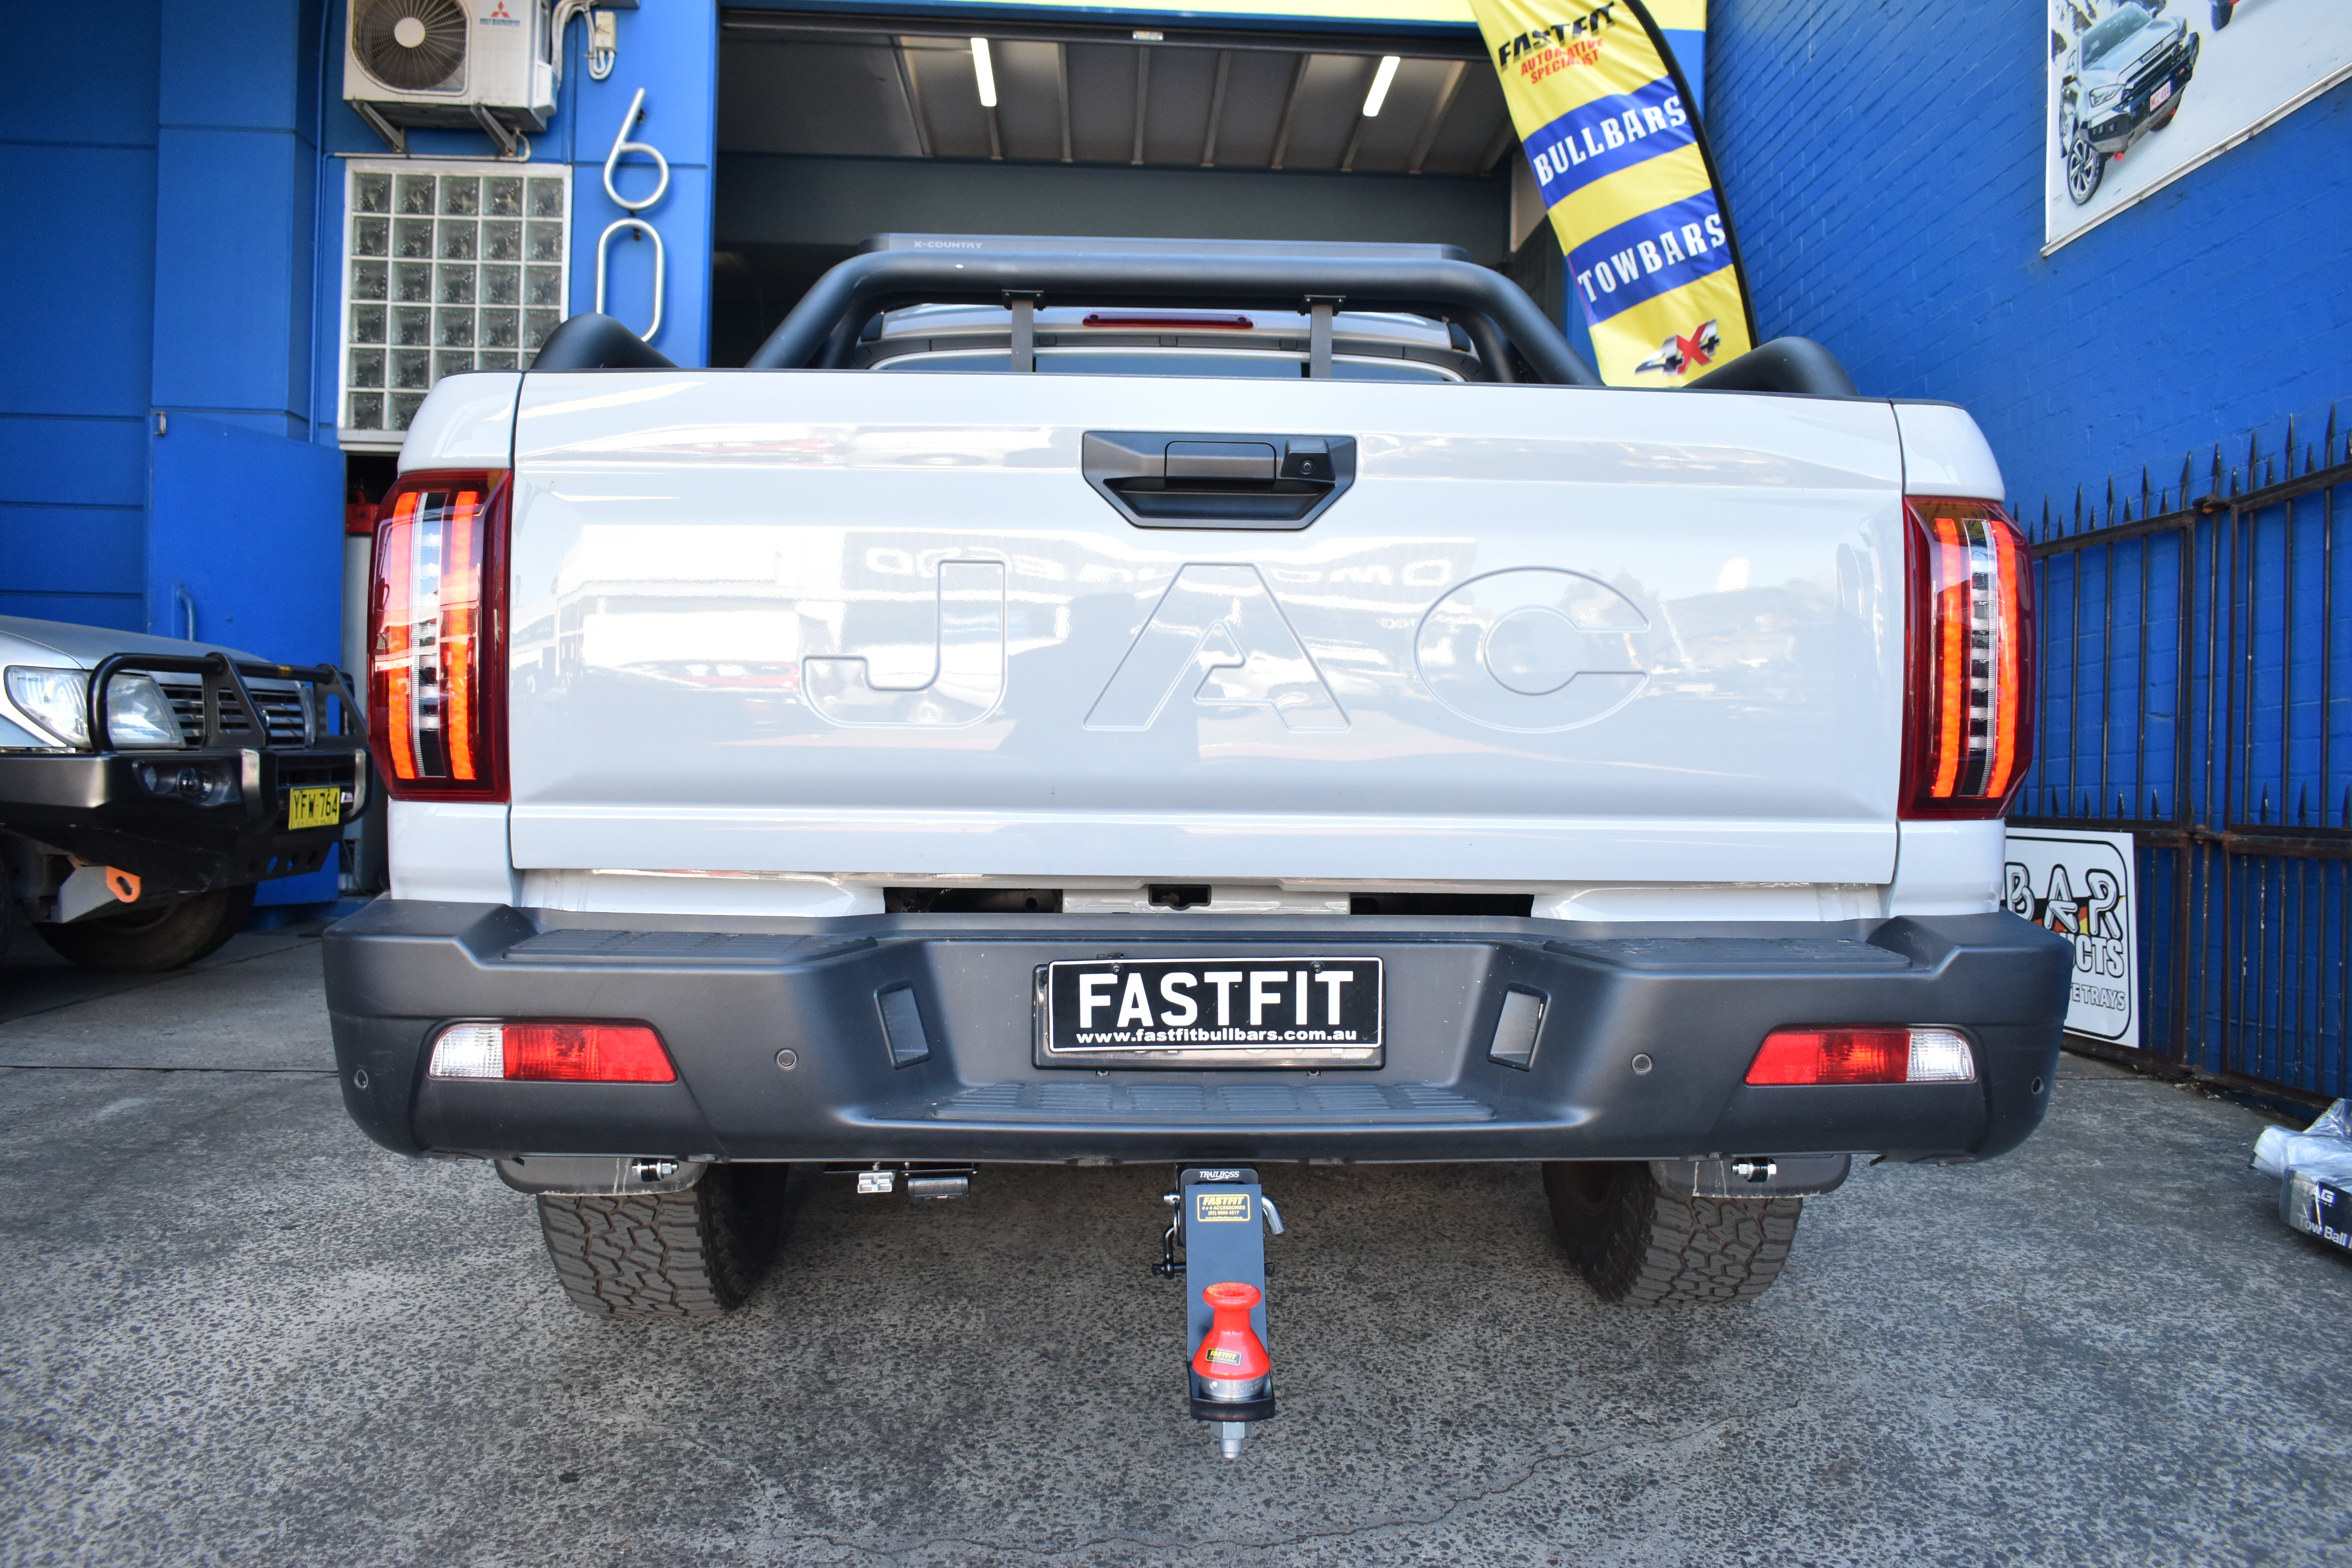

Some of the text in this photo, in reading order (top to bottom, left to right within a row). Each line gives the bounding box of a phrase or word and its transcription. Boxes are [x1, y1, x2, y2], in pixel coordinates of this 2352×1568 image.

[1498, 1, 1615, 71] FASTFIT
[1530, 49, 1599, 84] SPECIAIST
[1533, 95, 1687, 187] BULLBARS
[914, 240, 983, 249] X-COUNTRY
[1577, 213, 1726, 303] TOWBARS
[801, 559, 1651, 734] JAC
[1079, 971, 1354, 1028] FASTFIT
[2081, 984, 2126, 1011] TRAYS
[1076, 1028, 1356, 1043] www.fastfitbullbars.com.au
[1199, 1171, 1240, 1180] TRAILBOSS
[1203, 1196, 1244, 1205] FASTFIT
[2298, 1213, 2322, 1235] Tow
[2323, 1225, 2347, 1247] Ball
[1210, 1350, 1237, 1359] FASTFIT
